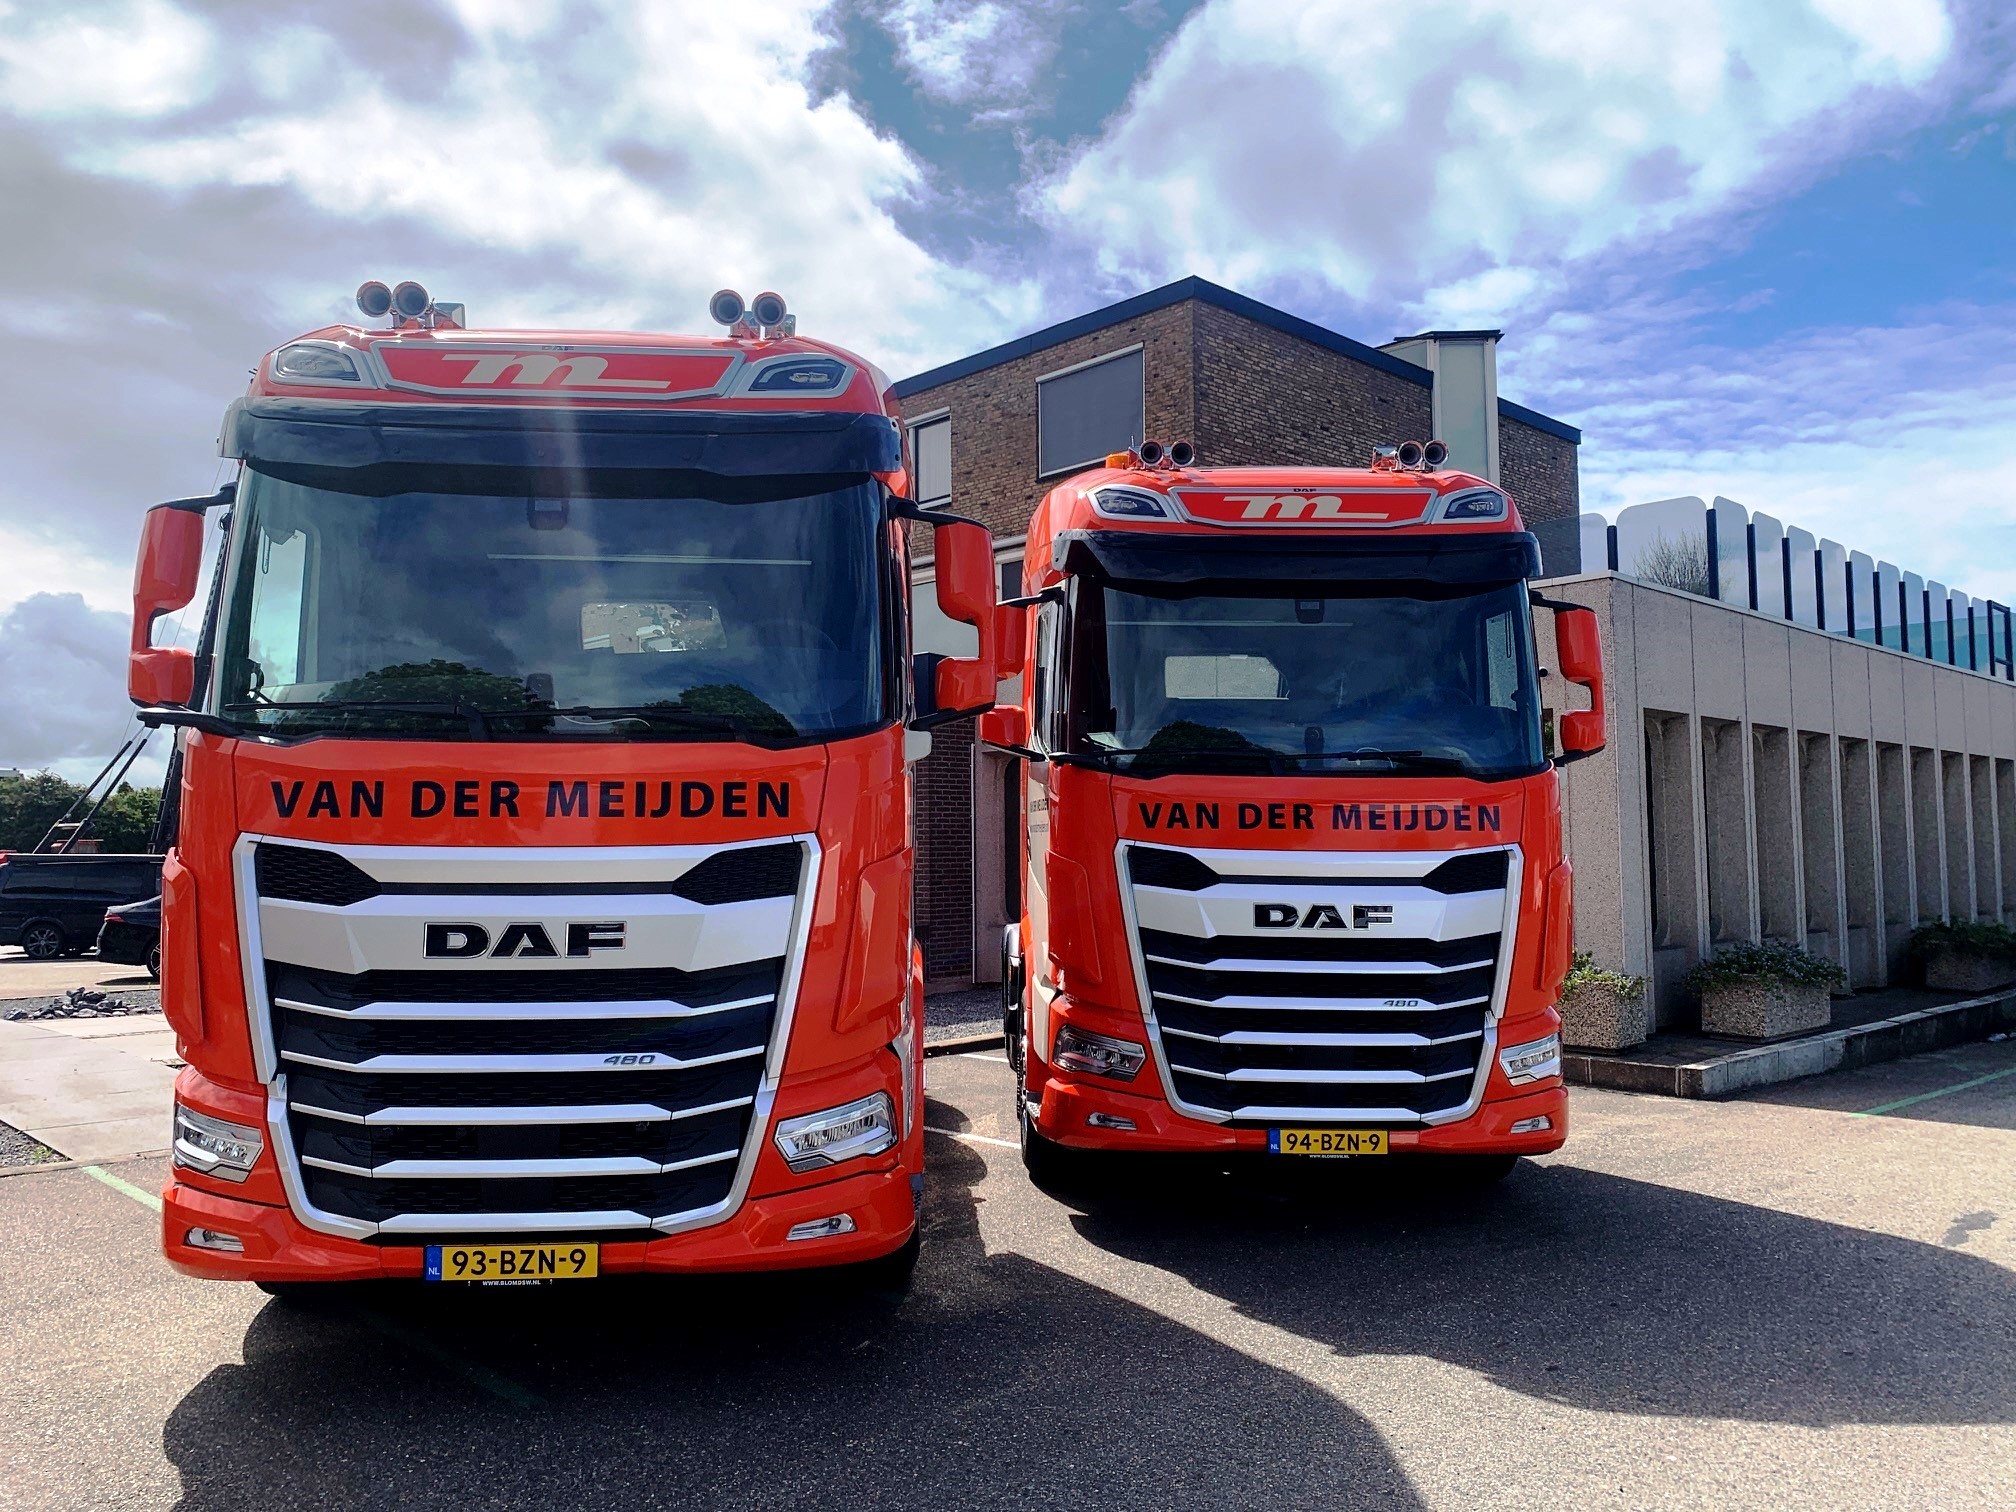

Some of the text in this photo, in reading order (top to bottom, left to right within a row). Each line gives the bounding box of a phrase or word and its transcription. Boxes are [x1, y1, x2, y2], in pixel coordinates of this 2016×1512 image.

[270, 780, 790, 818] VAN DER MEIJDEN
[1138, 802, 1501, 832] VAN DER MEIJDEN
[1252, 902, 1395, 931] DAF
[422, 921, 628, 960] DAF
[1383, 1000, 1419, 1008] 480
[602, 1054, 656, 1066] 480
[1286, 1132, 1382, 1152] 94-BZN-9
[428, 1266, 441, 1276] NL
[452, 1248, 587, 1276] 93-BZN-9
